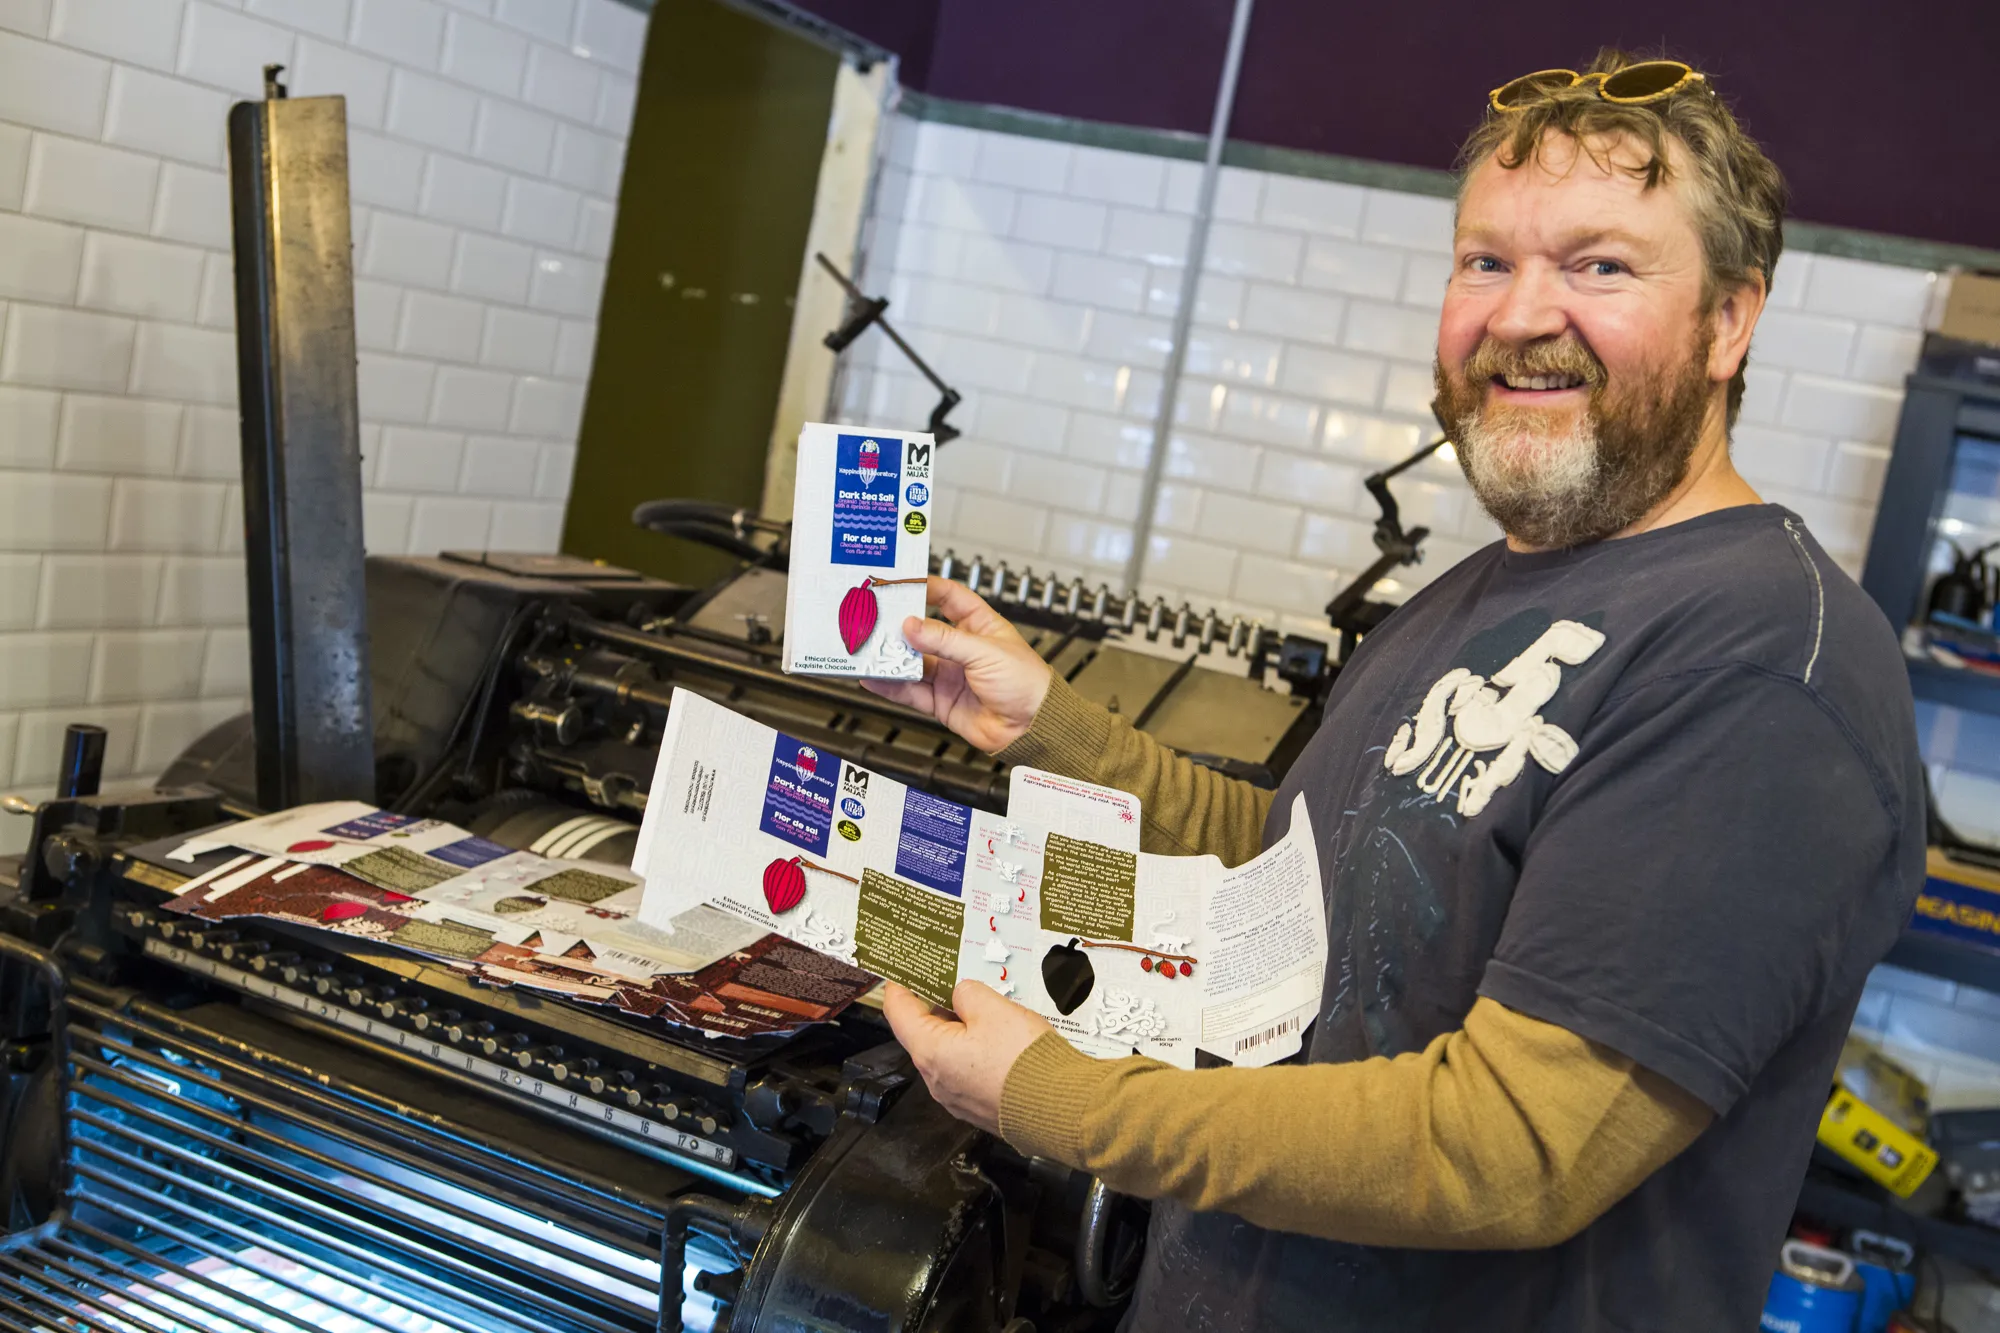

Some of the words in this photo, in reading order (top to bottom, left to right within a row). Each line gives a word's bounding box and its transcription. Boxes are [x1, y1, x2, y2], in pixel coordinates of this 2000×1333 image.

[839, 490, 860, 500] Dark
[862, 492, 877, 501] Sea
[878, 493, 894, 502] Salt
[912, 485, 927, 495] má
[843, 533, 859, 542] Flor
[861, 535, 872, 543] de
[874, 535, 886, 544] sal
[794, 662, 823, 670] Exquisite
[844, 782, 859, 791] MADE
[1023, 777, 1050, 789] ethically
[774, 775, 795, 790] Dark
[796, 785, 812, 798] Sea
[813, 793, 830, 806] Salt
[843, 785, 866, 799] MIJAS
[1052, 785, 1086, 799] consuming
[1112, 802, 1129, 810] Thank
[774, 811, 791, 824] Flor
[792, 819, 804, 830] de
[805, 824, 818, 836] sal
[712, 898, 742, 914] Exquisite
[744, 912, 778, 929] Chocolate
[724, 896, 746, 909] Ethical
[748, 906, 770, 919] Cacao
[431, 1046, 440, 1058] 10
[466, 1058, 473, 1070] 11
[500, 1070, 509, 1082] 12
[534, 1082, 542, 1096] 13
[569, 1095, 578, 1108] 14
[604, 1108, 613, 1121] 15
[640, 1120, 650, 1134] 16
[677, 1134, 686, 1146] 17
[714, 1147, 724, 1160] 18
